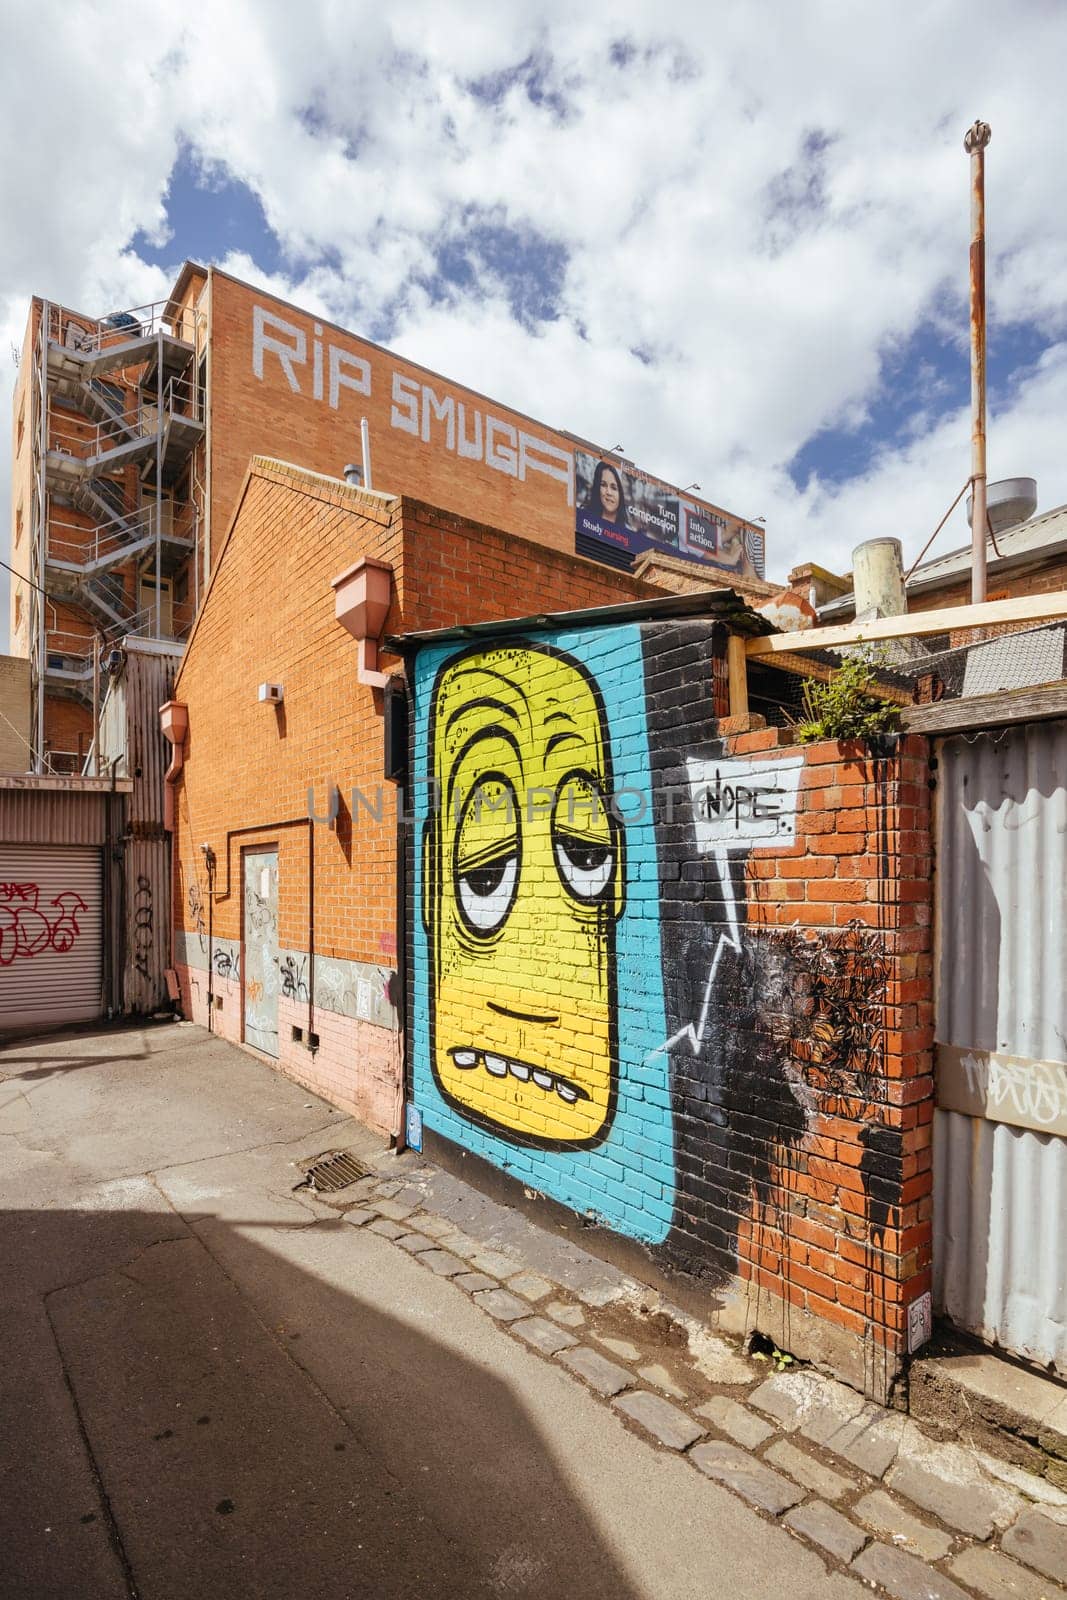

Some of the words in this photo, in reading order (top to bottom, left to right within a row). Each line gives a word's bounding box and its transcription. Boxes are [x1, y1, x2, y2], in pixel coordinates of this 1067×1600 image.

[628, 505, 676, 532] compassion
[658, 504, 676, 521] Turn
[583, 519, 602, 536] Study
[603, 529, 629, 547] nursing
[689, 518, 705, 534] into
[689, 533, 714, 549] action.
